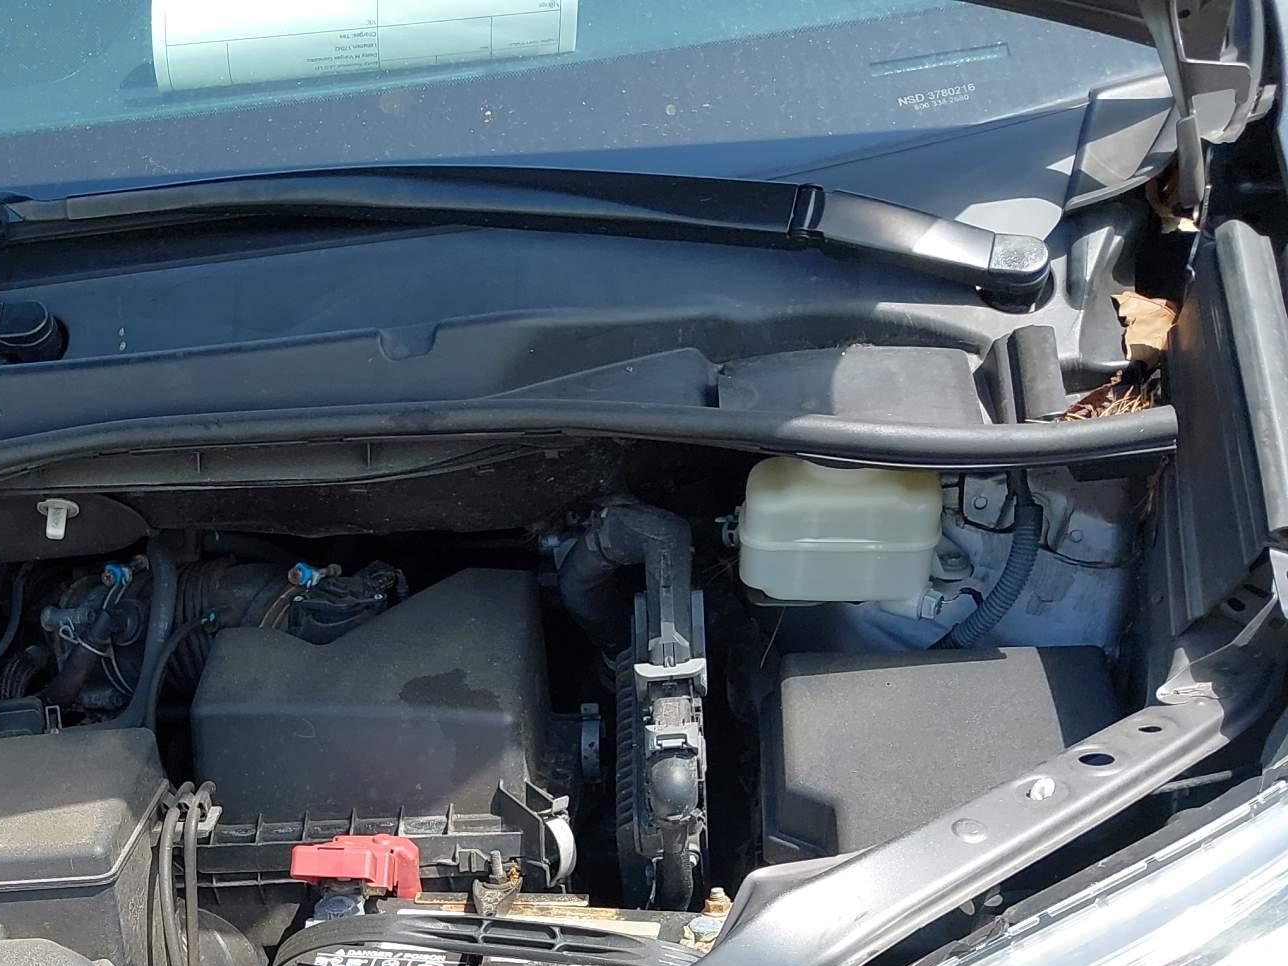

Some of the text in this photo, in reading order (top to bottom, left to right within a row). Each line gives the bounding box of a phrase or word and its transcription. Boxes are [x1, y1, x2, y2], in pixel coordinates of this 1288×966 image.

[897, 83, 976, 107] NSD 3780216
[347, 950, 394, 959] DANGER
[403, 952, 447, 961] POISON
